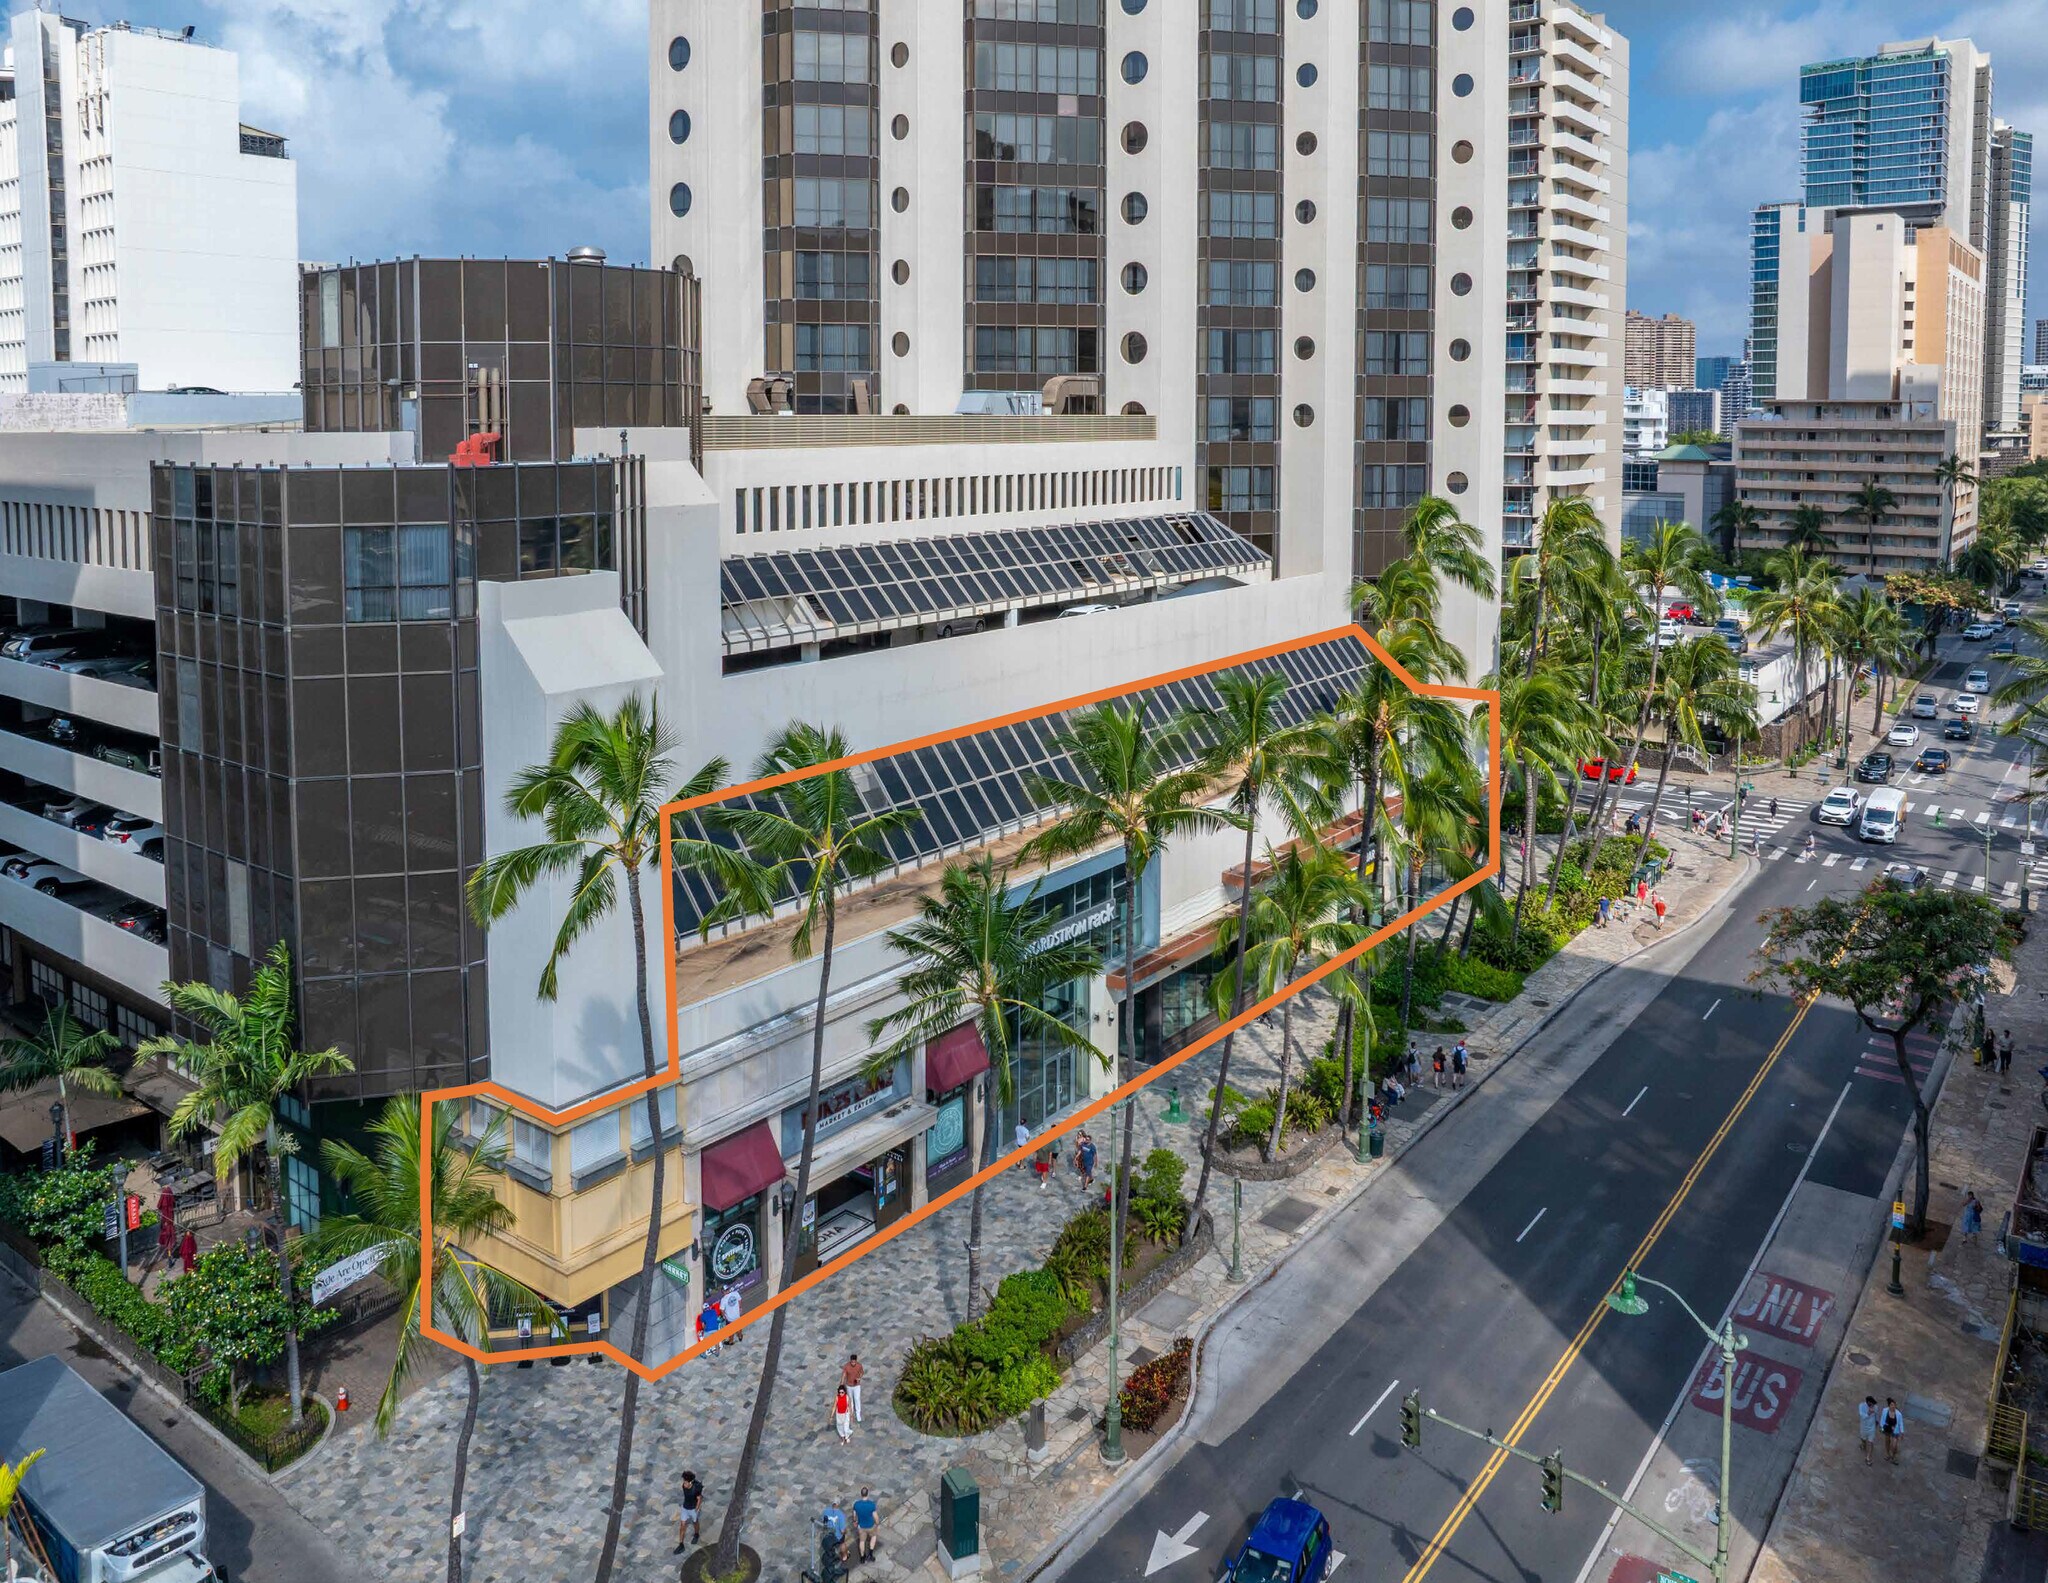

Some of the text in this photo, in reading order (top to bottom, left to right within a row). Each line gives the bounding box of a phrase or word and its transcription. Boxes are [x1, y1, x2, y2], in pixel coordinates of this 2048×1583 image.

[1088, 903, 1115, 930] rack
[819, 1111, 846, 1129] MARKET
[854, 1095, 878, 1111] EATERY
[338, 1265, 351, 1279] Are
[352, 1255, 376, 1271] Open
[662, 1262, 688, 1282] MARKET
[1700, 1358, 1787, 1420] BUS
